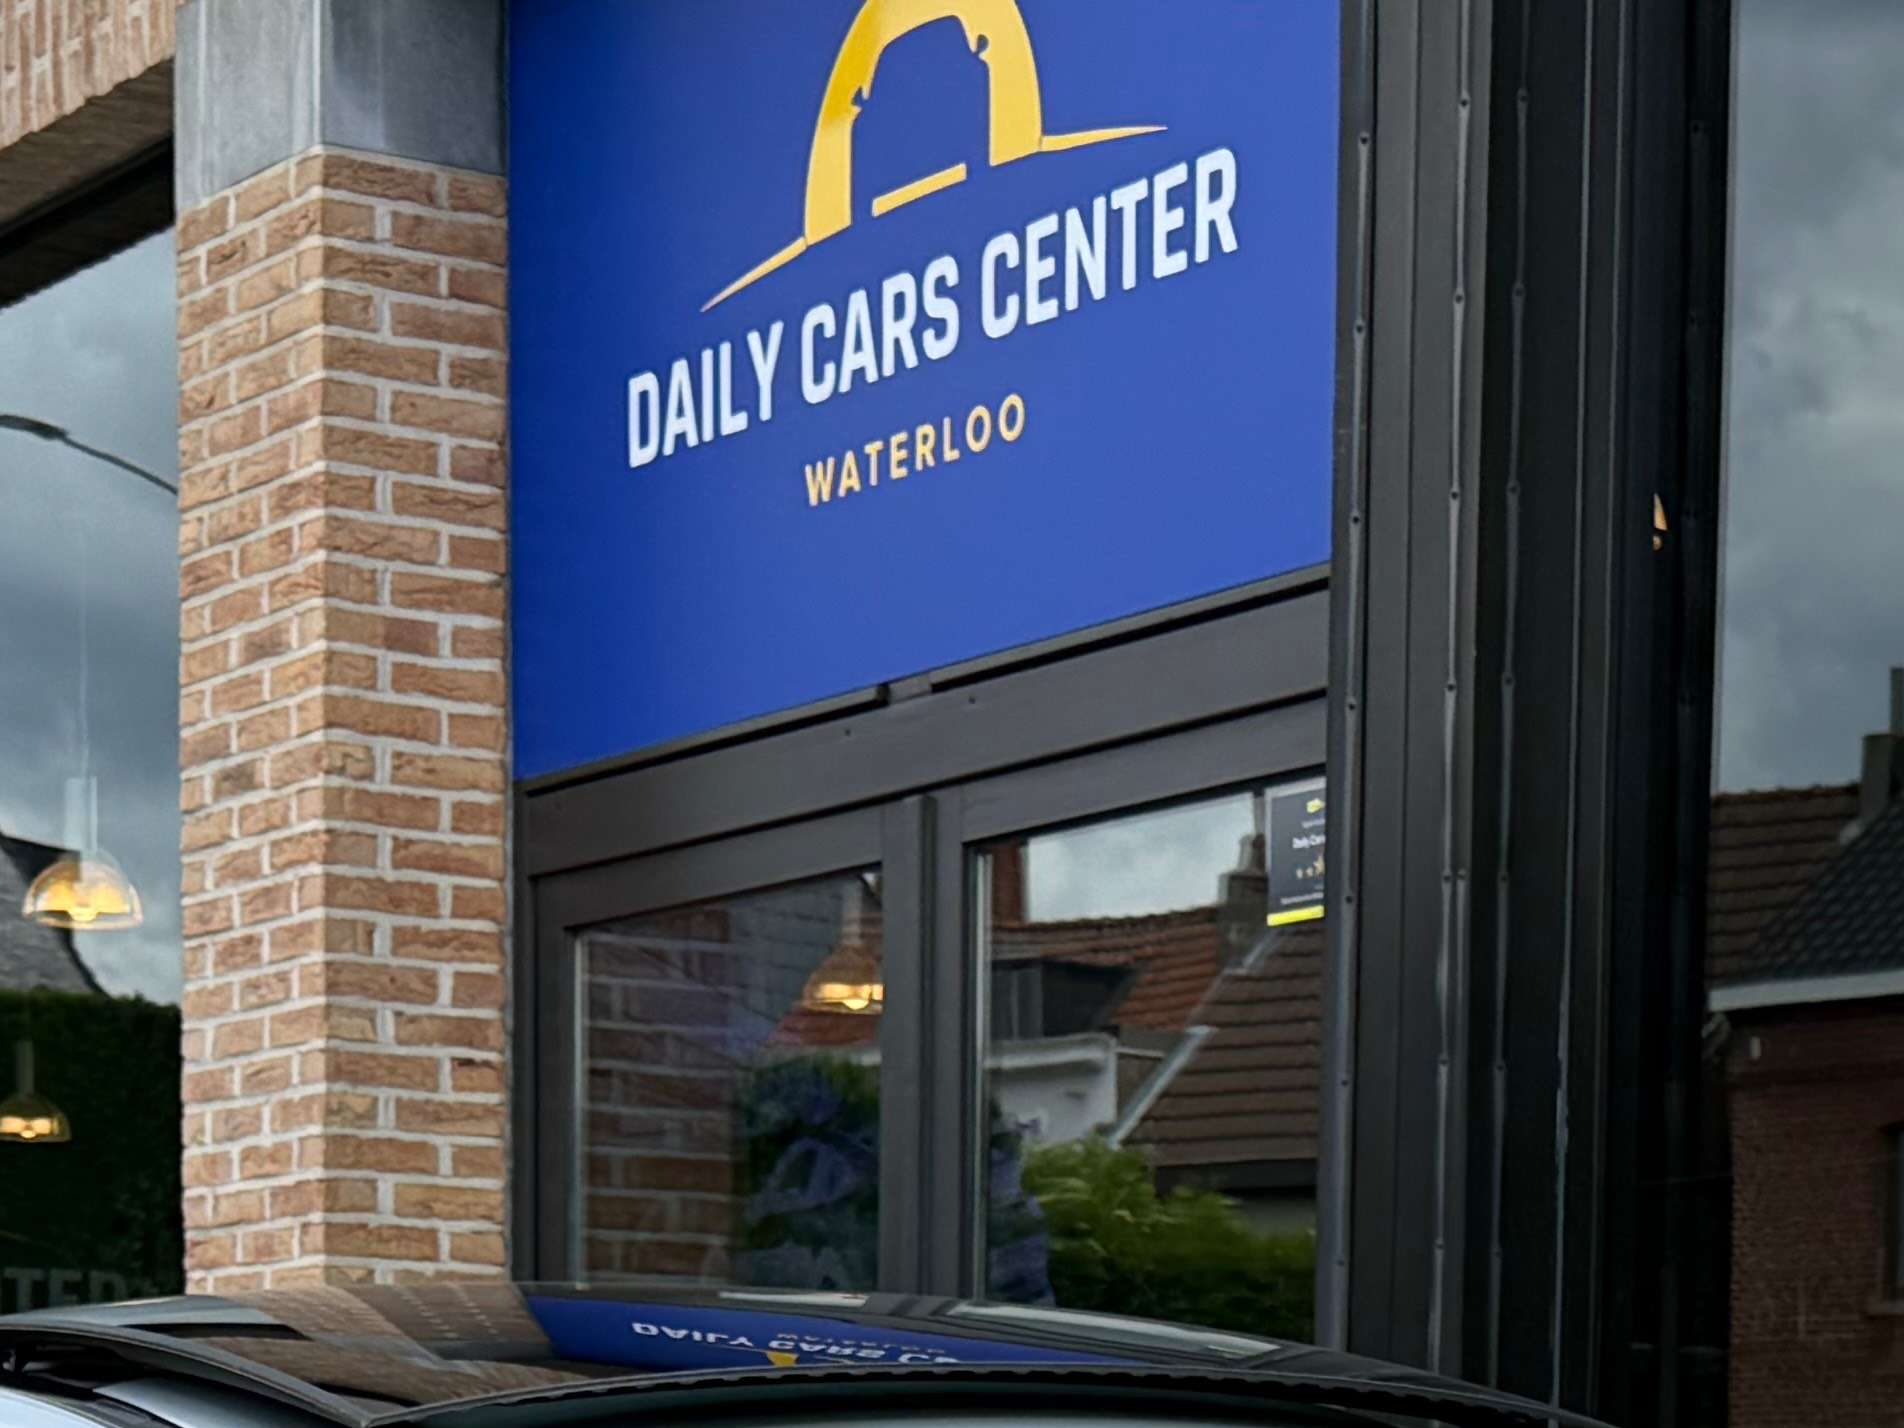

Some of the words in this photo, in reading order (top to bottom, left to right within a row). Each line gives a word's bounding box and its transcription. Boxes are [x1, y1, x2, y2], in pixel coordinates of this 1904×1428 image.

[628, 321, 785, 469] DAILY
[800, 255, 961, 405] CARS
[981, 147, 1238, 340] CENTER
[805, 393, 1025, 506] WATERLOO
